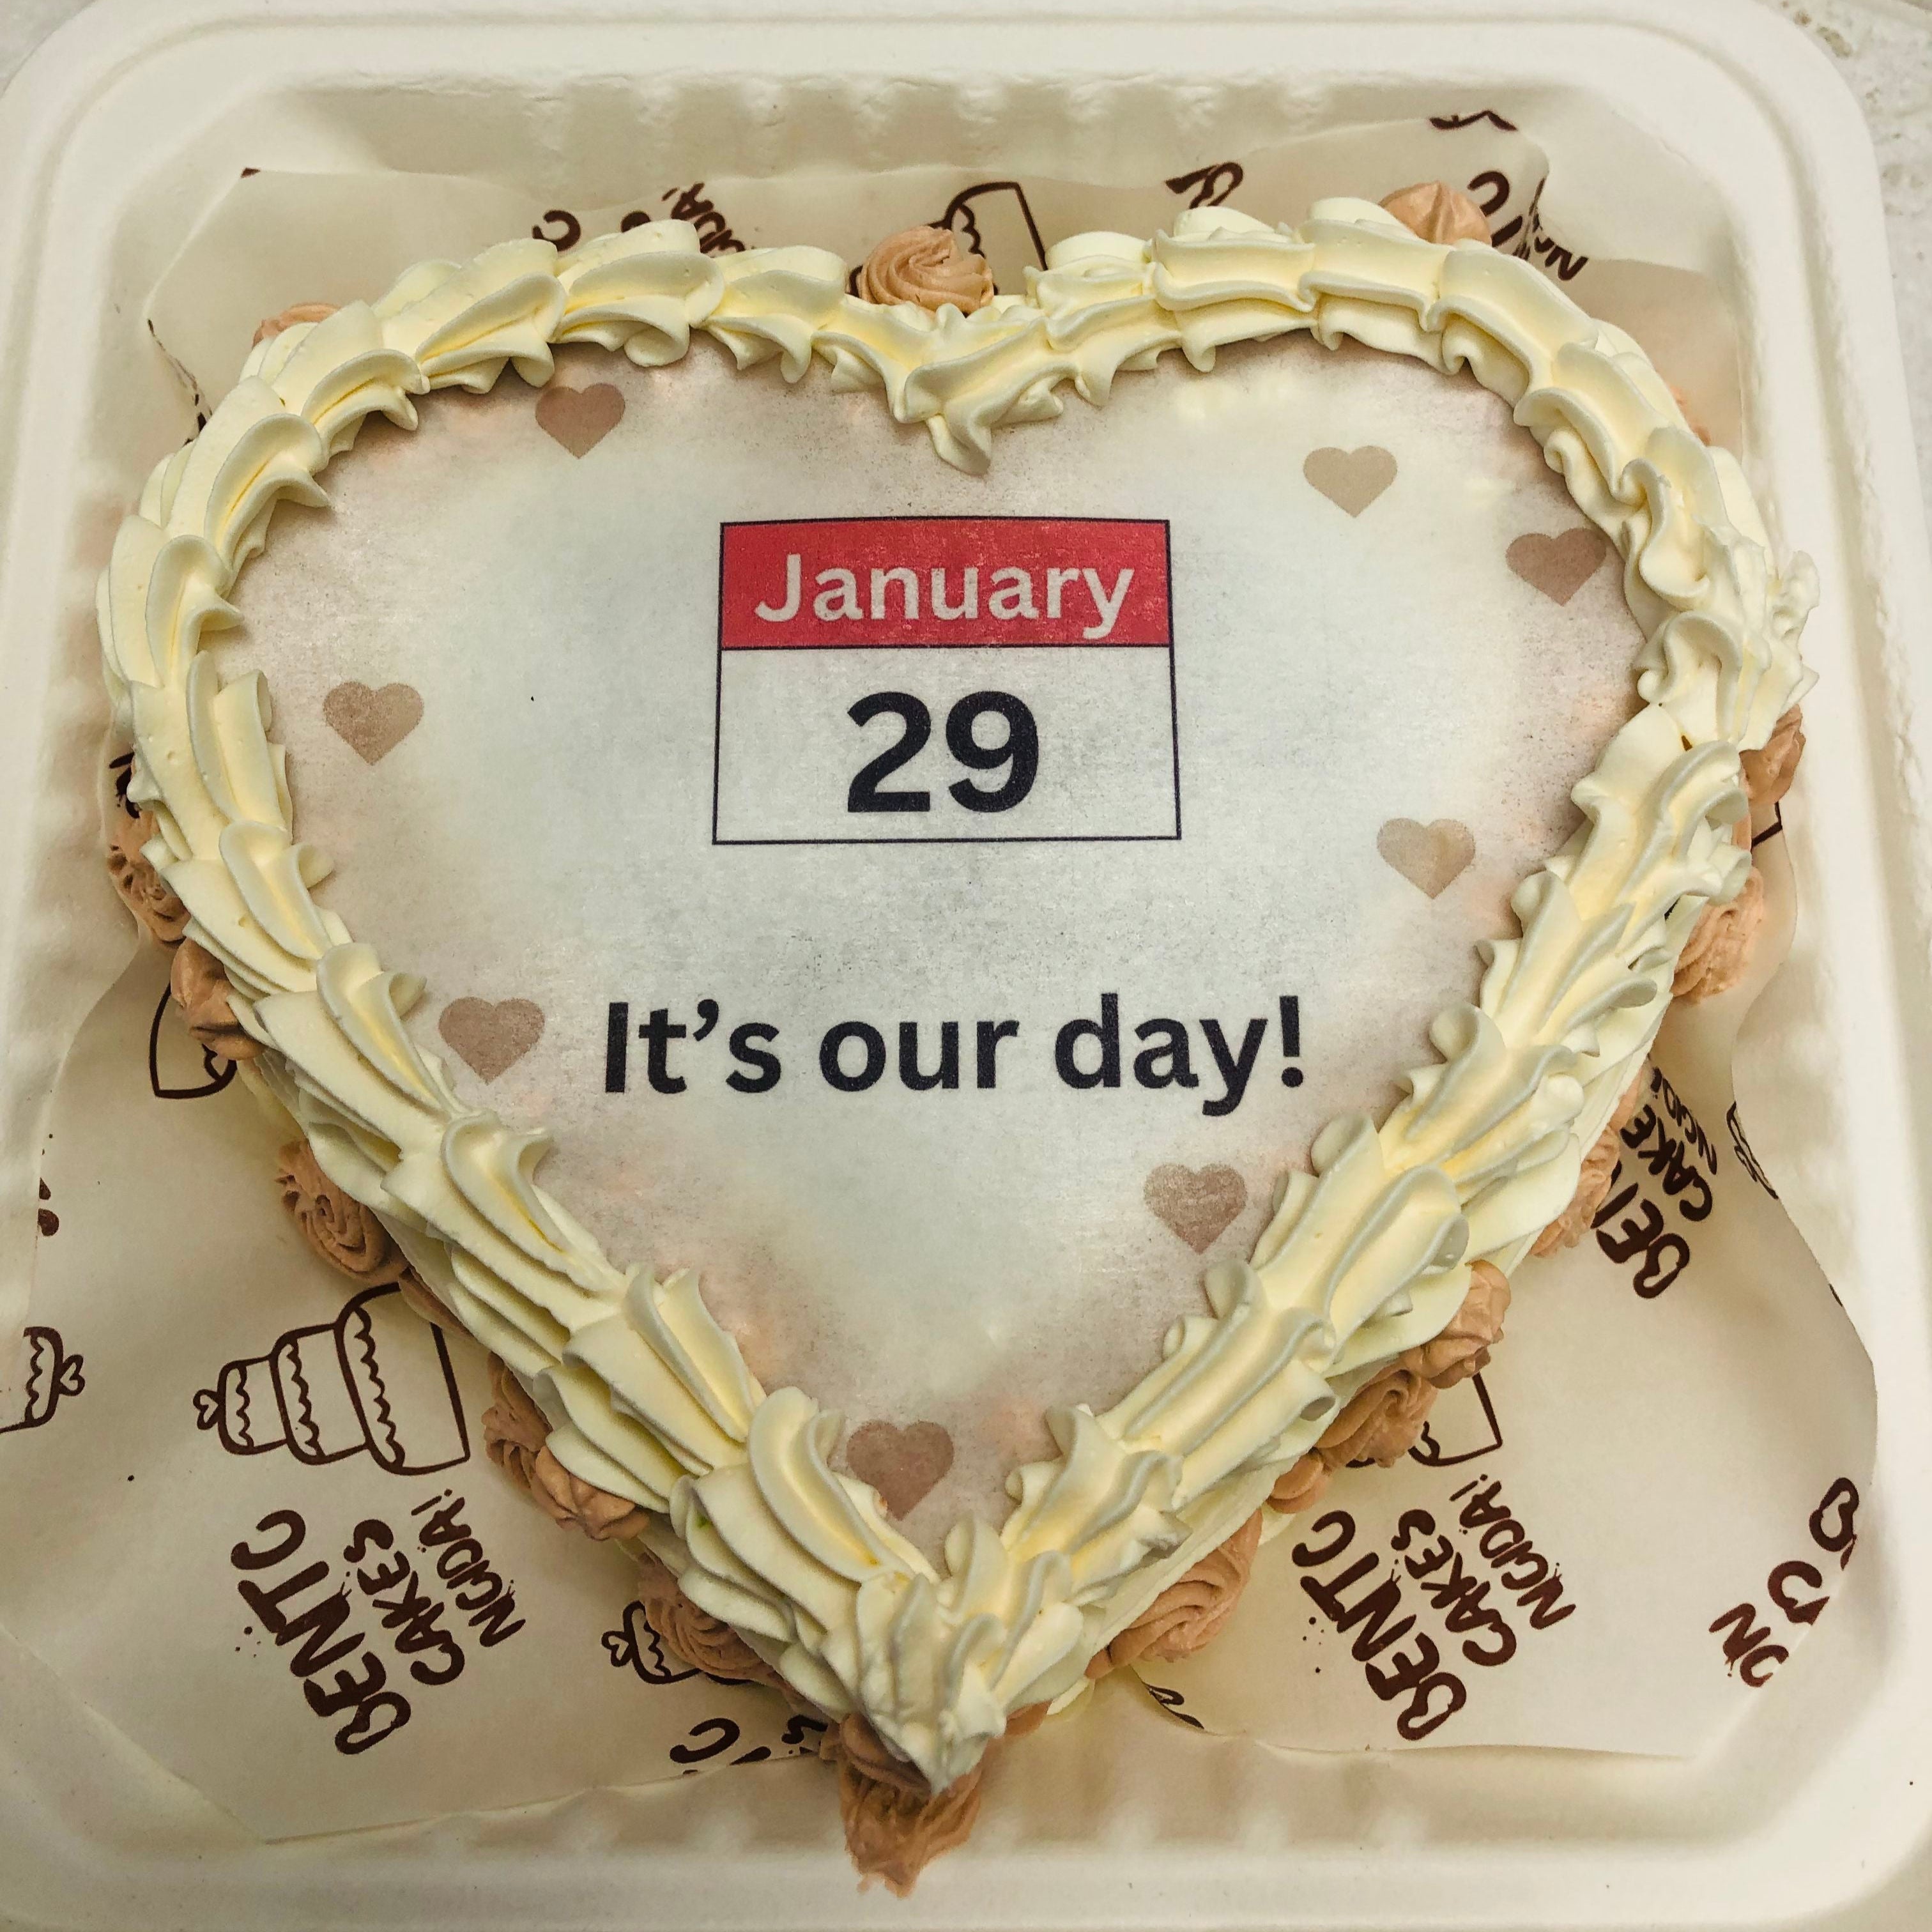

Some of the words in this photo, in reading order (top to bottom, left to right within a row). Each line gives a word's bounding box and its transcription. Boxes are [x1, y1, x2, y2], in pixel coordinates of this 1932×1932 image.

[754, 553, 1135, 640] January
[847, 691, 1039, 813] 29
[604, 999, 782, 1094] It’s
[818, 1020, 1020, 1092] our
[1054, 992, 1304, 1117] day!
[343, 1519, 465, 1686] CAKES
[1390, 1509, 1517, 1666] CAKES
